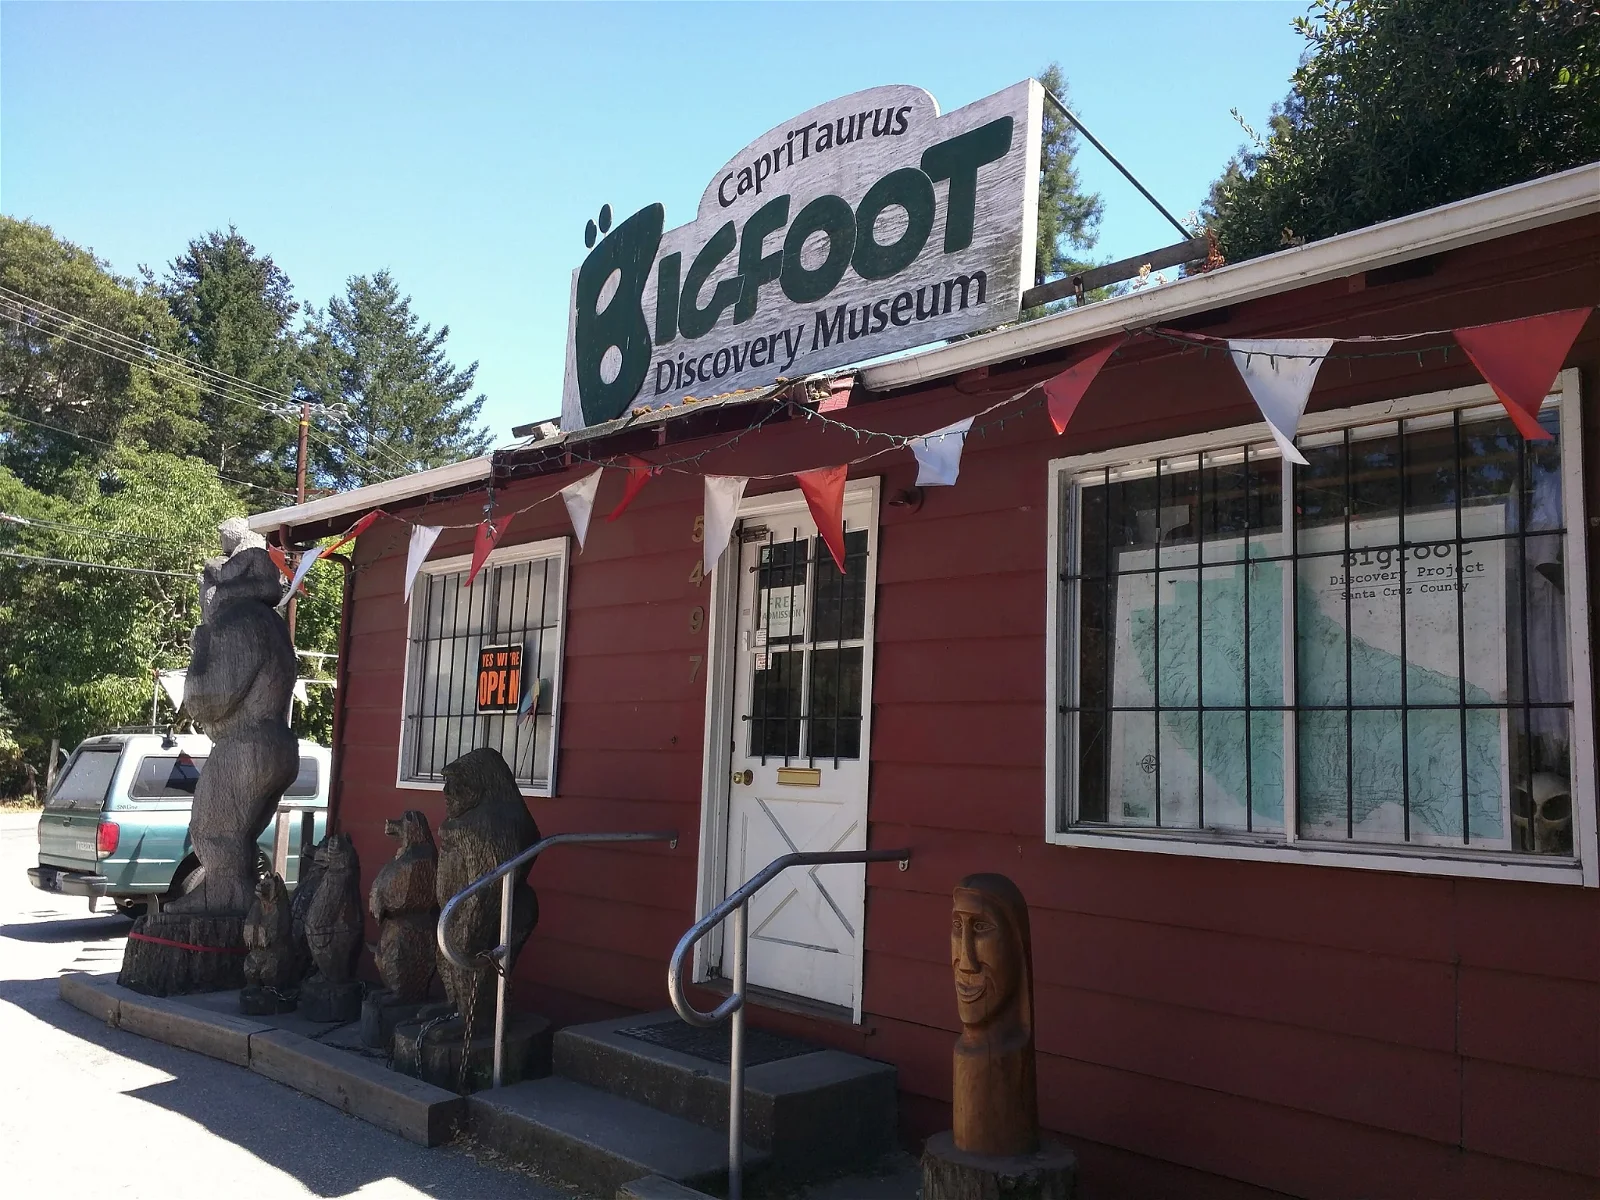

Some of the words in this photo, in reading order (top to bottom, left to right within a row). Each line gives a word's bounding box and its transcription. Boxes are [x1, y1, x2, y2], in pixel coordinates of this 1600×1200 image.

[717, 105, 912, 208] CapriTaurus
[575, 115, 1013, 426] BIGFOOT
[654, 323, 806, 397] Discovery
[810, 270, 988, 352] Museum
[1329, 569, 1408, 586] Discovery
[1340, 589, 1376, 600] Santa
[1420, 581, 1470, 593] County
[762, 608, 801, 620] ADMISSON
[482, 653, 494, 667] YES
[480, 669, 519, 705] OPEN
